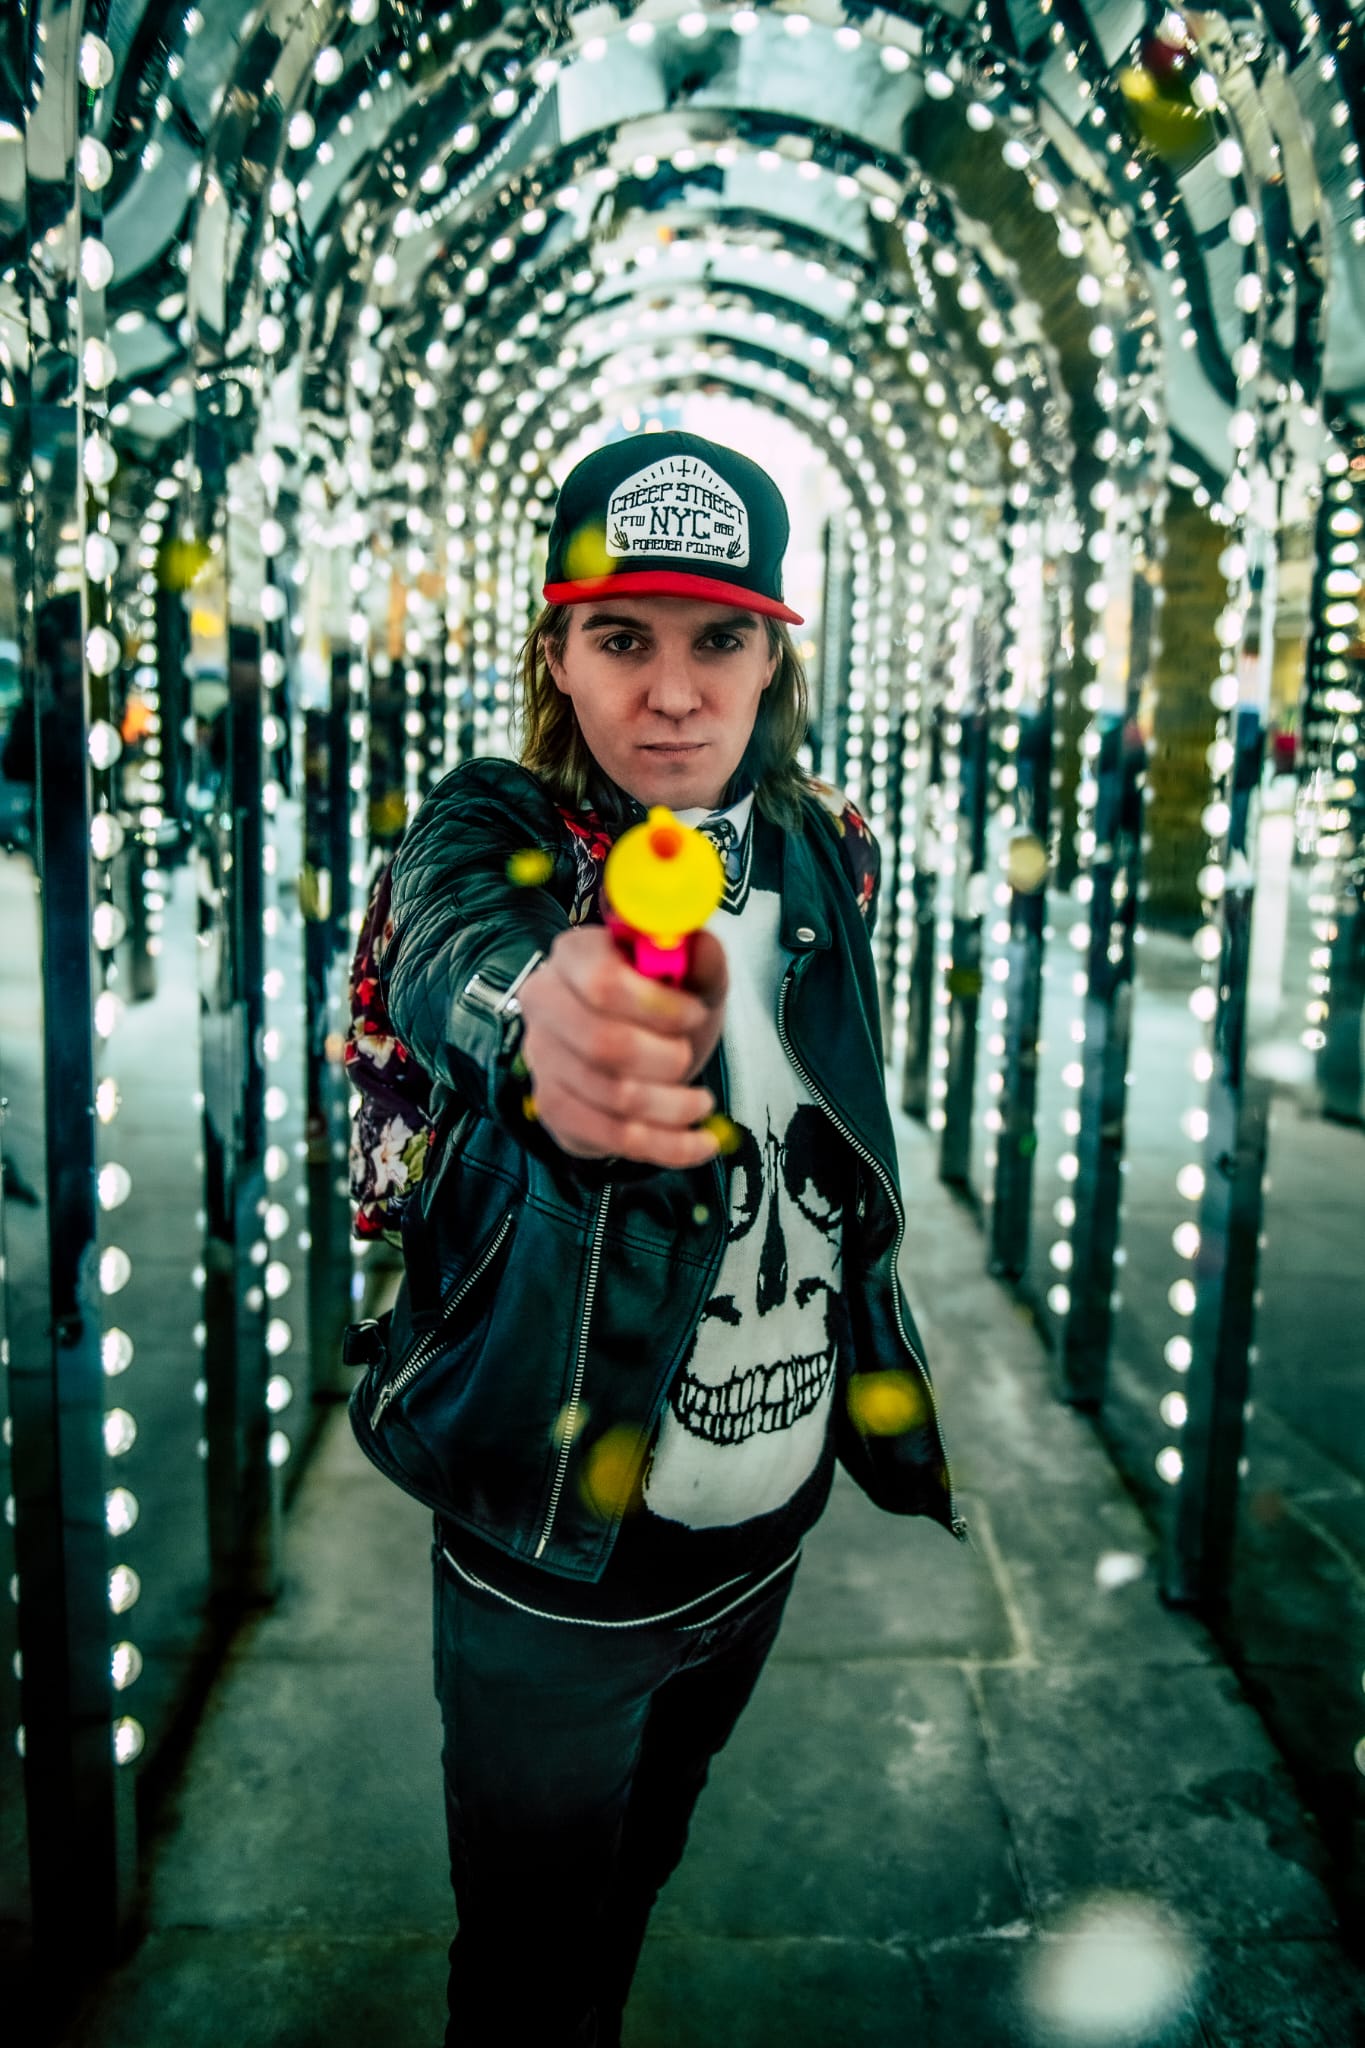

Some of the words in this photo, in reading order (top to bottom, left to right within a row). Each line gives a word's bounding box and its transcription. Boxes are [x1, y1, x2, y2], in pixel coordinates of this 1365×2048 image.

[611, 483, 673, 514] CREEP
[675, 482, 744, 525] STREET
[650, 506, 710, 539] NYC
